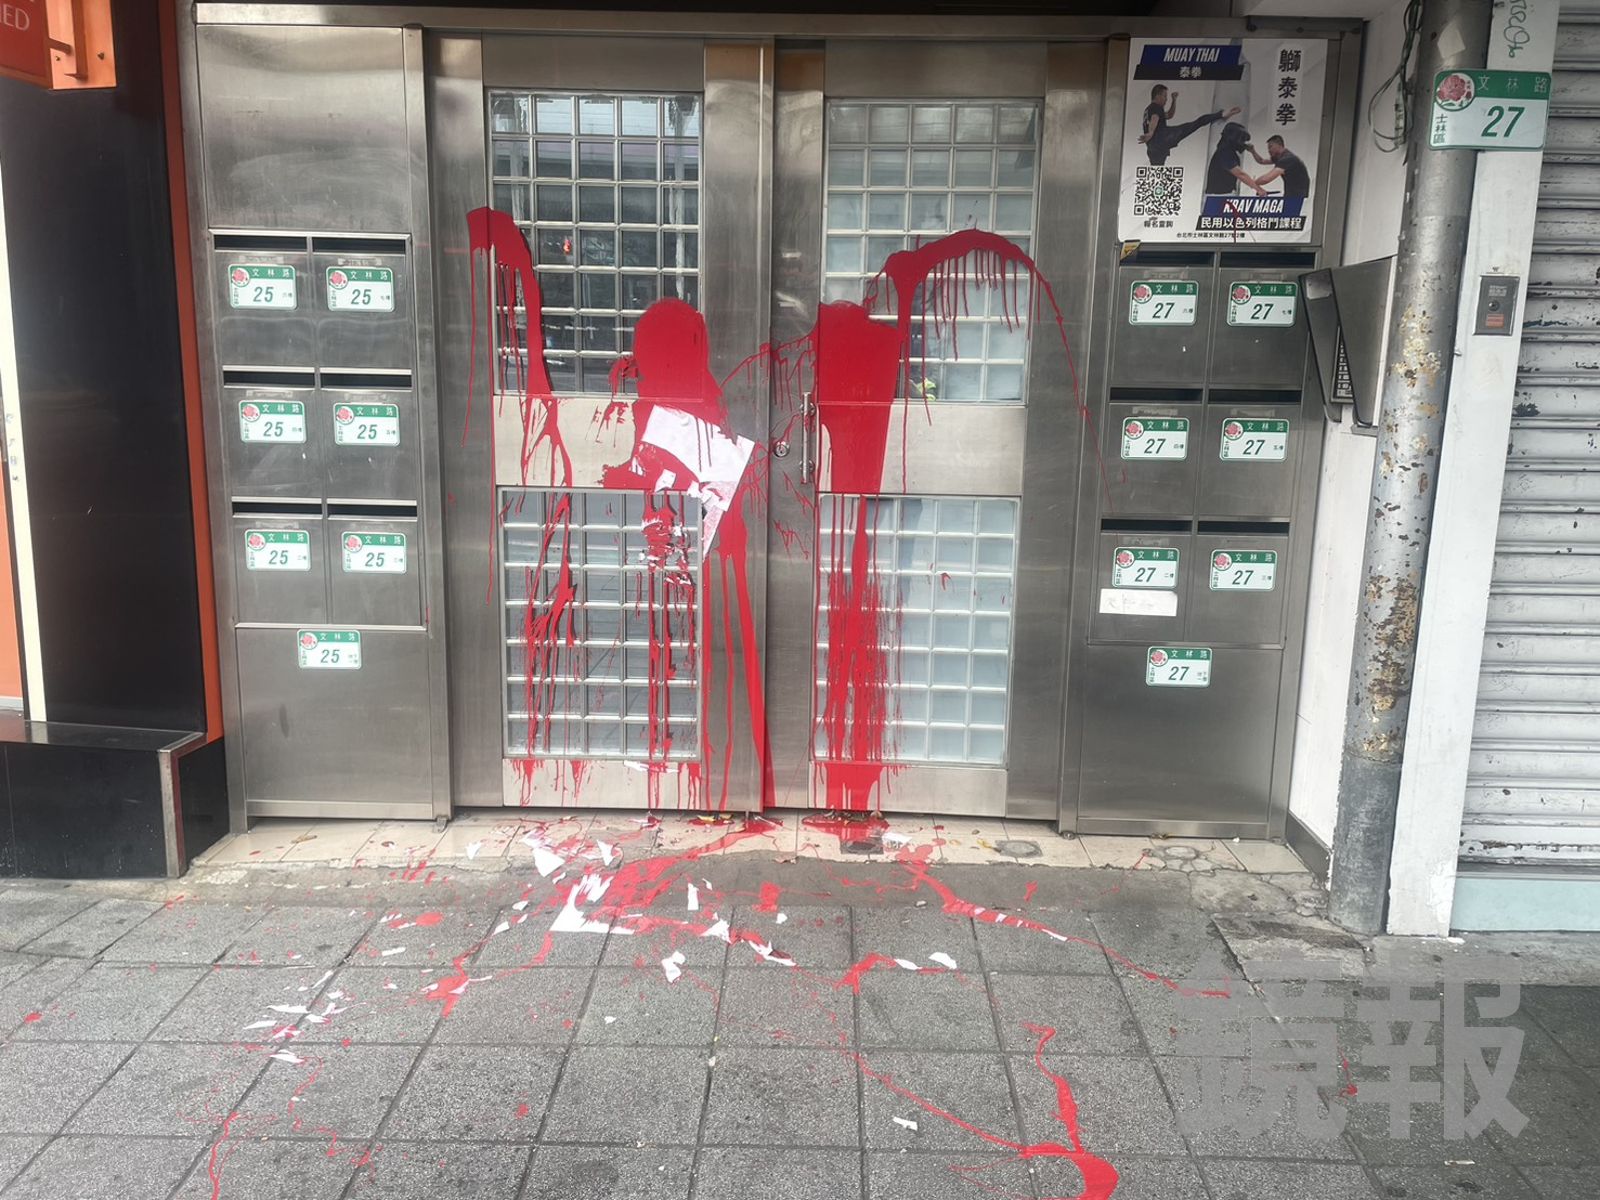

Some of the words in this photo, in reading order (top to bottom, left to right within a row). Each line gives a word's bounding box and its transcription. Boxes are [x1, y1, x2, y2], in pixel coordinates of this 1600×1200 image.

[0, 3, 30, 31] ED
[1163, 48, 1194, 62] MUAY
[1195, 48, 1220, 62] THAI
[1179, 66, 1202, 79] 泰拳
[1477, 75, 1547, 93] 文林路
[1481, 106, 1526, 138] 27
[1252, 199, 1284, 213] MAGA
[253, 286, 274, 302] 25
[350, 289, 372, 305] 25
[1152, 302, 1175, 319] 27
[1251, 303, 1274, 320] 27
[263, 421, 284, 437] 25
[357, 424, 378, 440] 25
[1144, 438, 1166, 454] 27
[1243, 439, 1265, 455] 27
[268, 550, 289, 565] 25
[365, 552, 385, 567] 25
[1134, 567, 1156, 582] 27
[1232, 570, 1254, 585] 27
[320, 649, 340, 664] 25
[1168, 666, 1190, 681] 27
